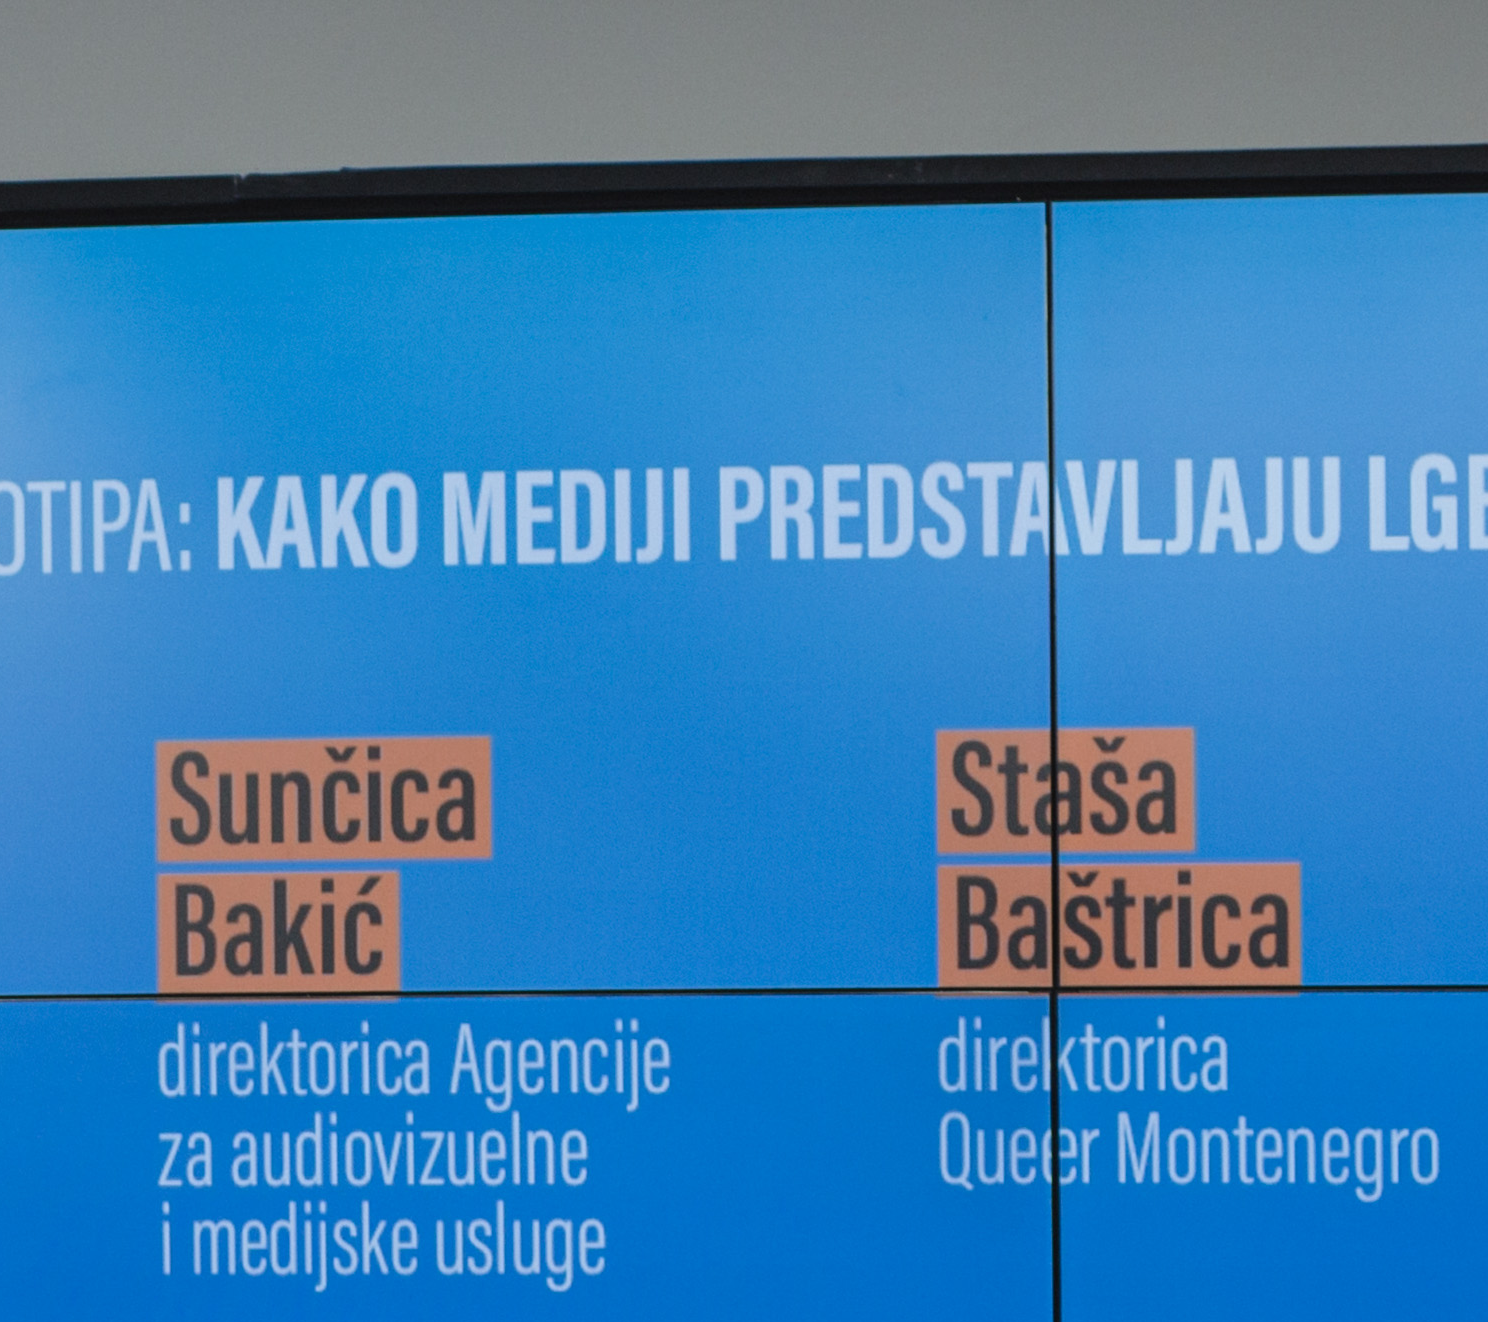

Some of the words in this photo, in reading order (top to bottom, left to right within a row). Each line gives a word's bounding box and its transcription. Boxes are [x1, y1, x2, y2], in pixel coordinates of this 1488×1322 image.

[216, 471, 418, 570] KAKO
[442, 467, 690, 566] MEDIJI
[719, 455, 1342, 561] PREDSTAVLJAJU
[170, 745, 476, 846] Sunčica
[951, 736, 1177, 837] Staša
[175, 876, 383, 976] Bakić
[957, 870, 1289, 970] Baštrica
[158, 1020, 430, 1097] direktorica
[449, 1019, 671, 1111] Agencije
[938, 1016, 1228, 1093] direktorica
[157, 1131, 213, 1187] za
[231, 1111, 588, 1188] audiovizuelne
[939, 1110, 1101, 1191] Queer
[1117, 1111, 1440, 1202] Montenegro
[162, 1202, 171, 1274] i
[193, 1201, 419, 1292] medijske
[436, 1200, 606, 1292] usluge
